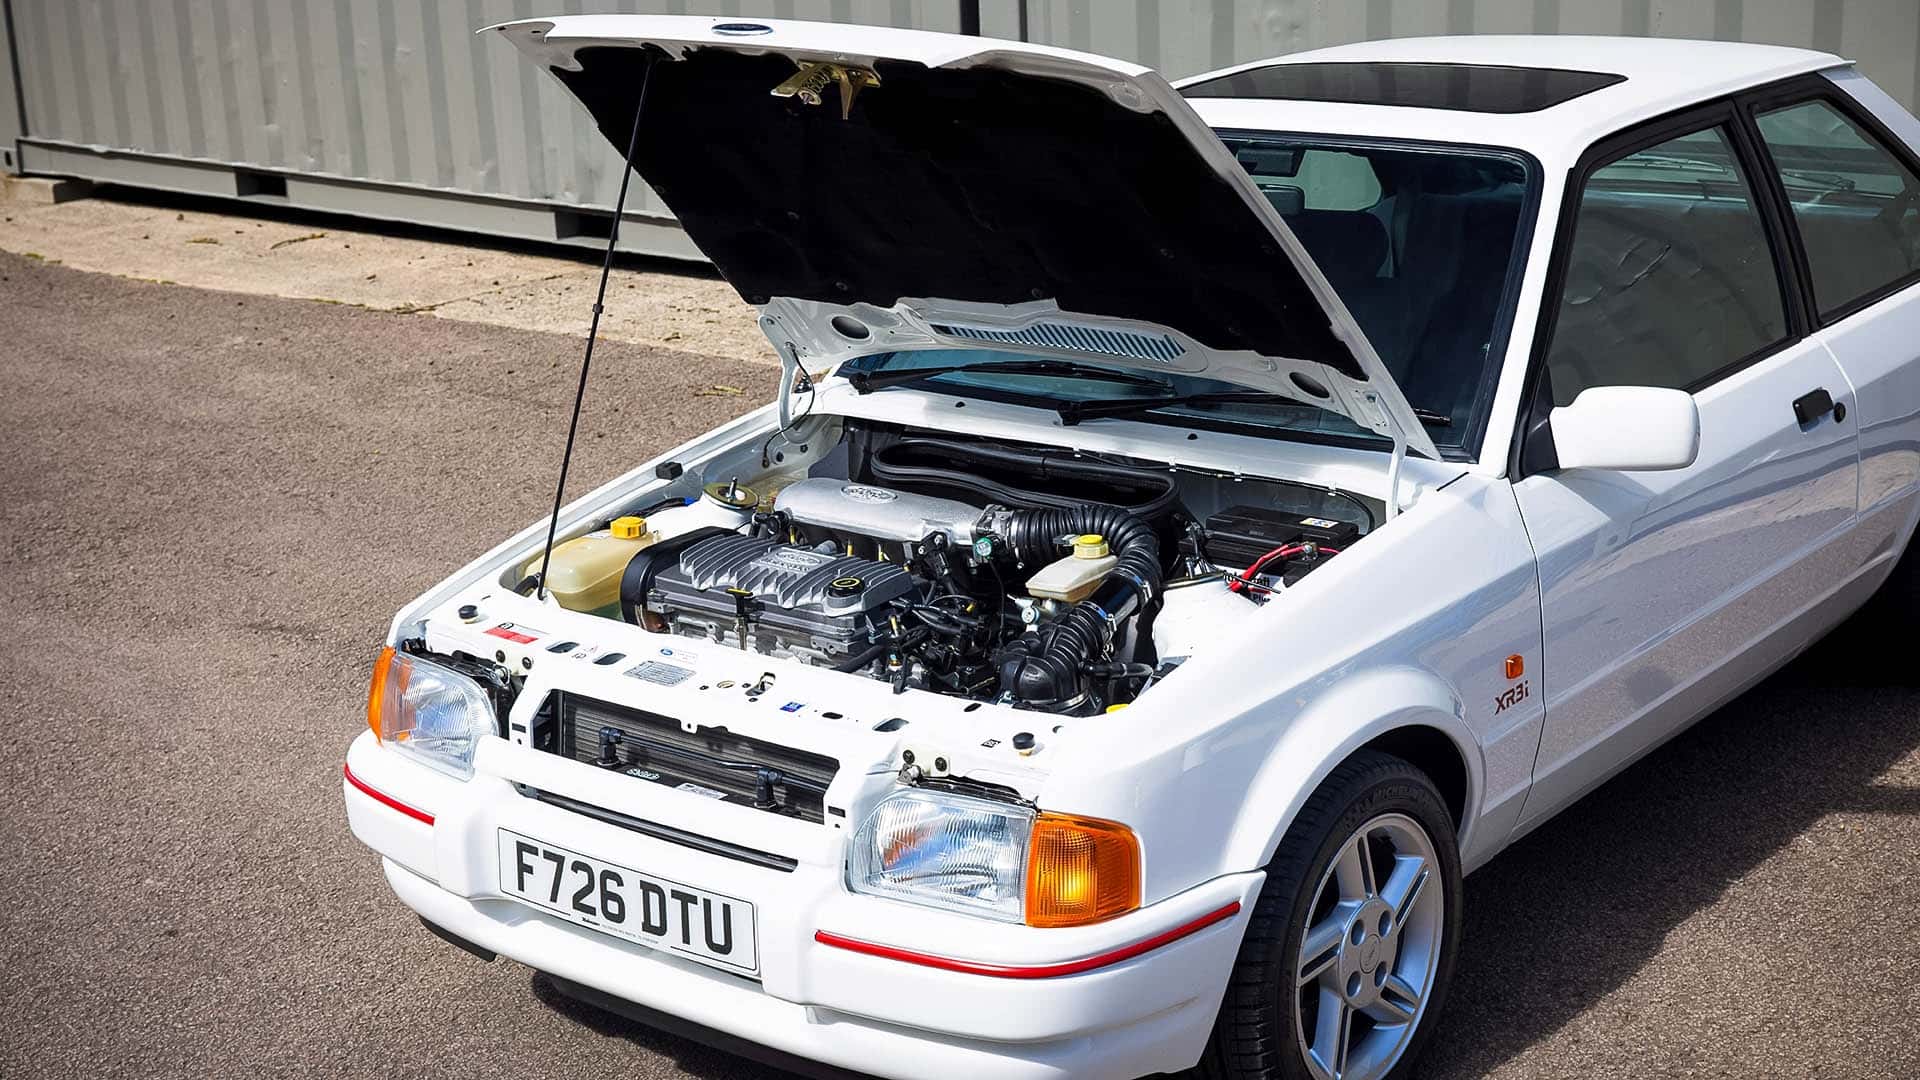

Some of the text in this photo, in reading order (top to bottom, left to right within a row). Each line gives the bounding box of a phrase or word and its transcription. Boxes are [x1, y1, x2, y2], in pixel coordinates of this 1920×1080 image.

[1494, 680, 1529, 715] XR3i
[515, 840, 733, 956] F726 DTU
